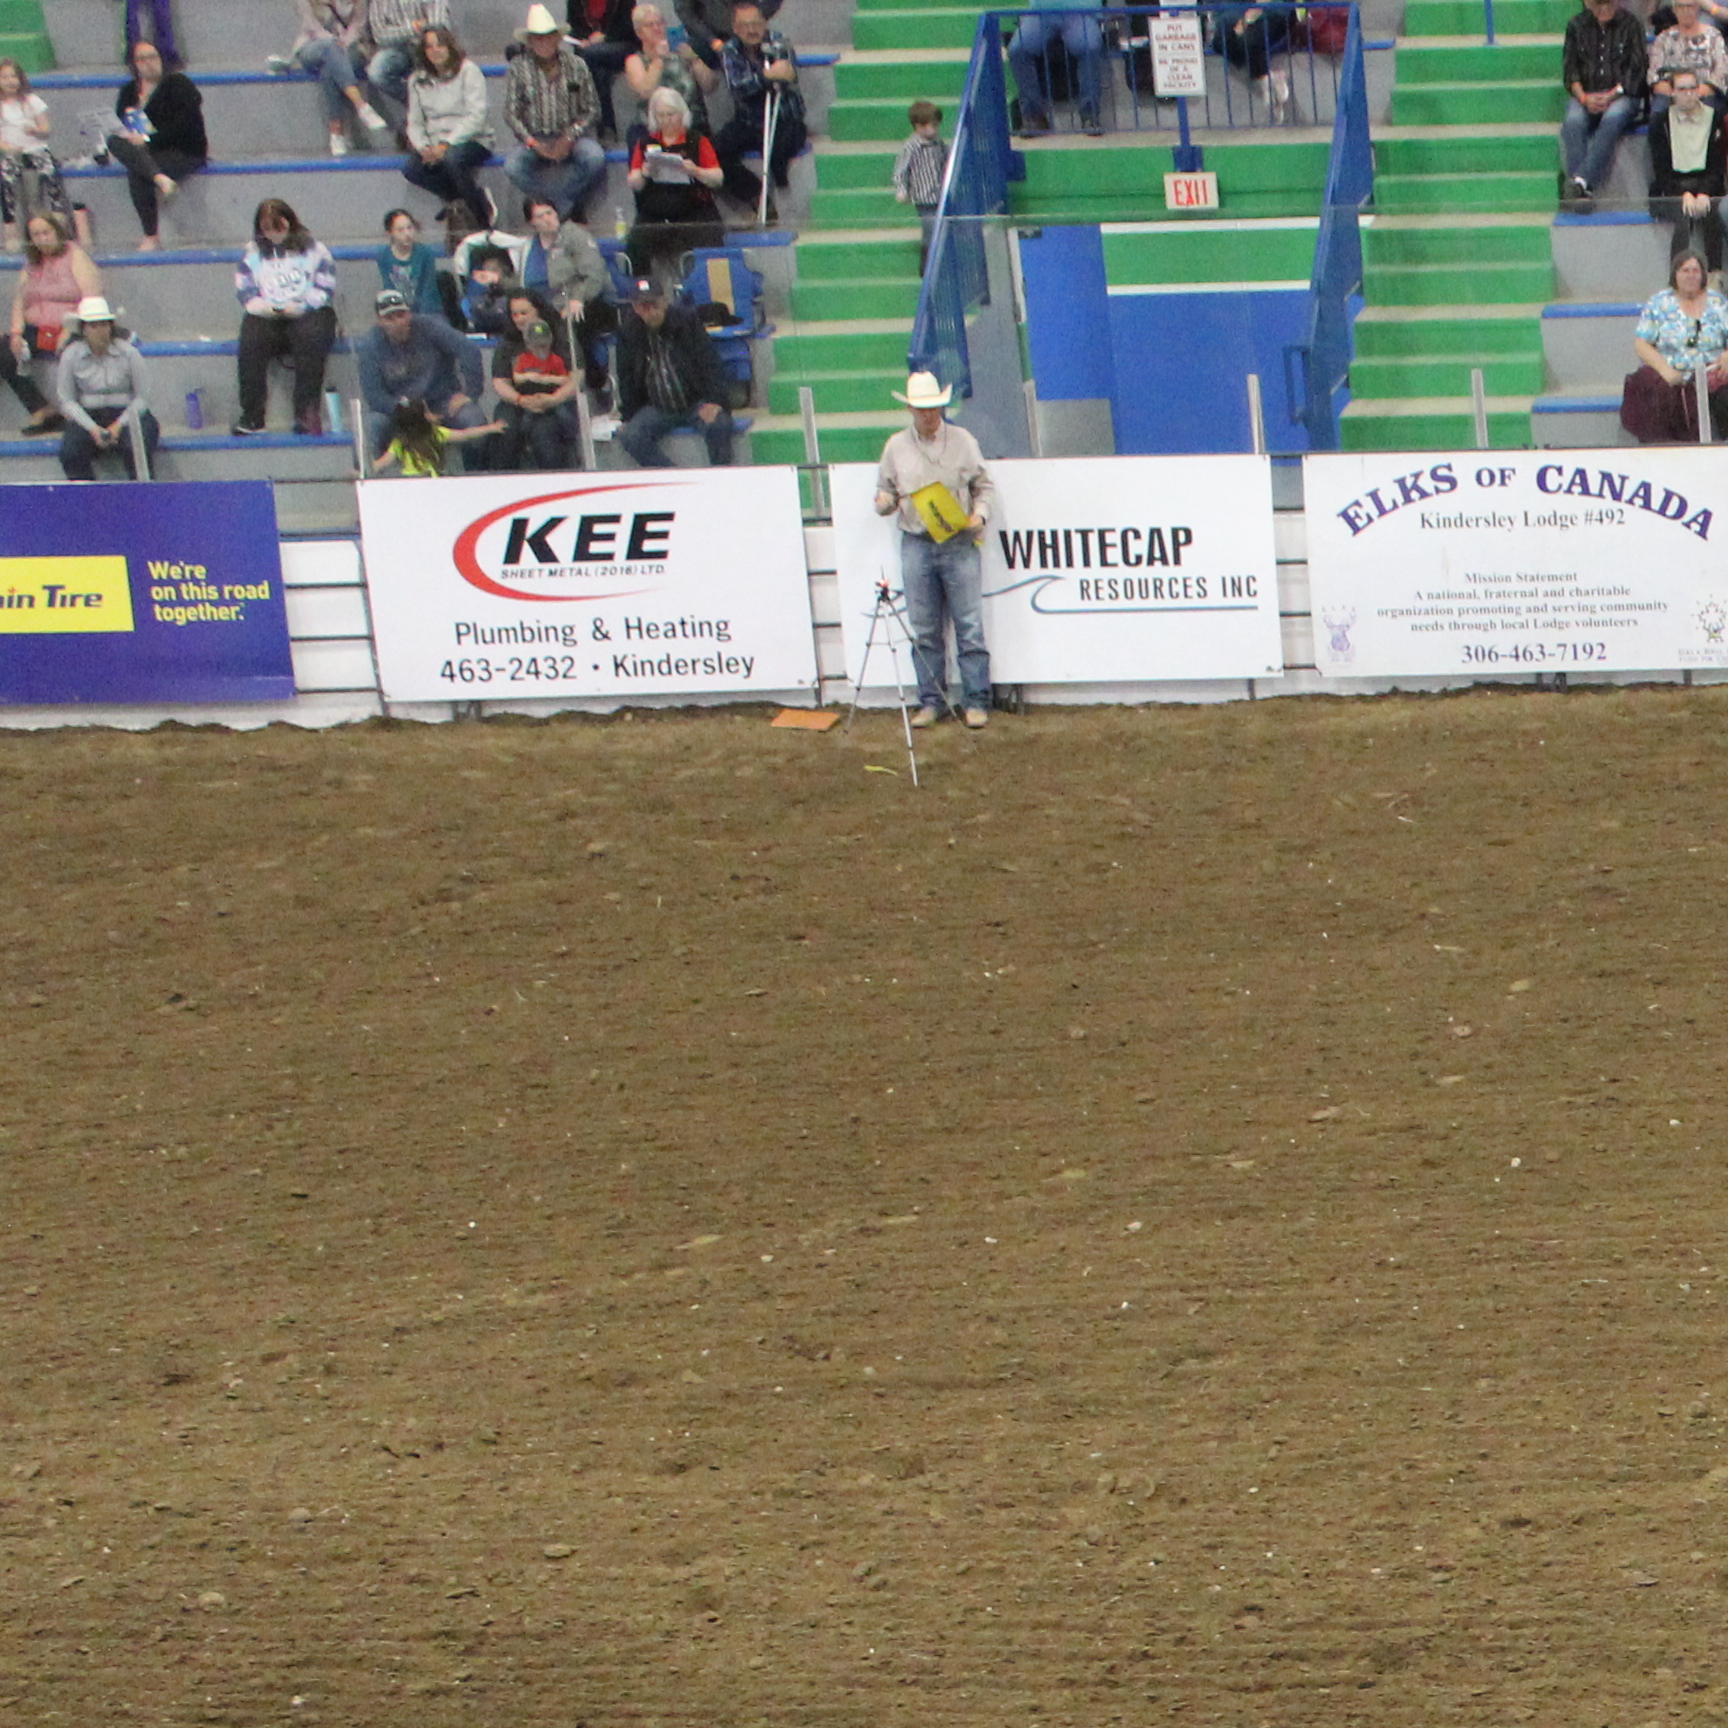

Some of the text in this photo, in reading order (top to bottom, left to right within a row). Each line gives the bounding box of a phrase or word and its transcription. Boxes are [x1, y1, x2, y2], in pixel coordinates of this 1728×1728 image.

[1156, 33, 1196, 41] GARBAGE
[1173, 178, 1208, 206] EXIT
[1337, 462, 1714, 541] ELKS OF CANADA
[1419, 509, 1625, 531] Kindersley Lodge #492
[502, 511, 675, 565] KEE
[999, 526, 1193, 570] WHITECAP
[147, 561, 207, 580] We're
[501, 568, 544, 580] SHEET
[548, 566, 592, 579] METAL
[1465, 571, 1578, 584] Mission Statement
[42, 584, 103, 608] Tire
[151, 580, 271, 601] on this road
[1079, 575, 1259, 602] RESOURCES INC
[1414, 585, 1631, 602] A national, fraternal and charitable
[1376, 600, 1669, 618] organization promoting and serving community
[454, 615, 732, 647] Plumbing & Heating
[1410, 617, 1639, 632] needs through local Lodge volunteers
[1461, 642, 1608, 664] 306-463-7192
[439, 652, 755, 684] 463-2432 Kindersley
